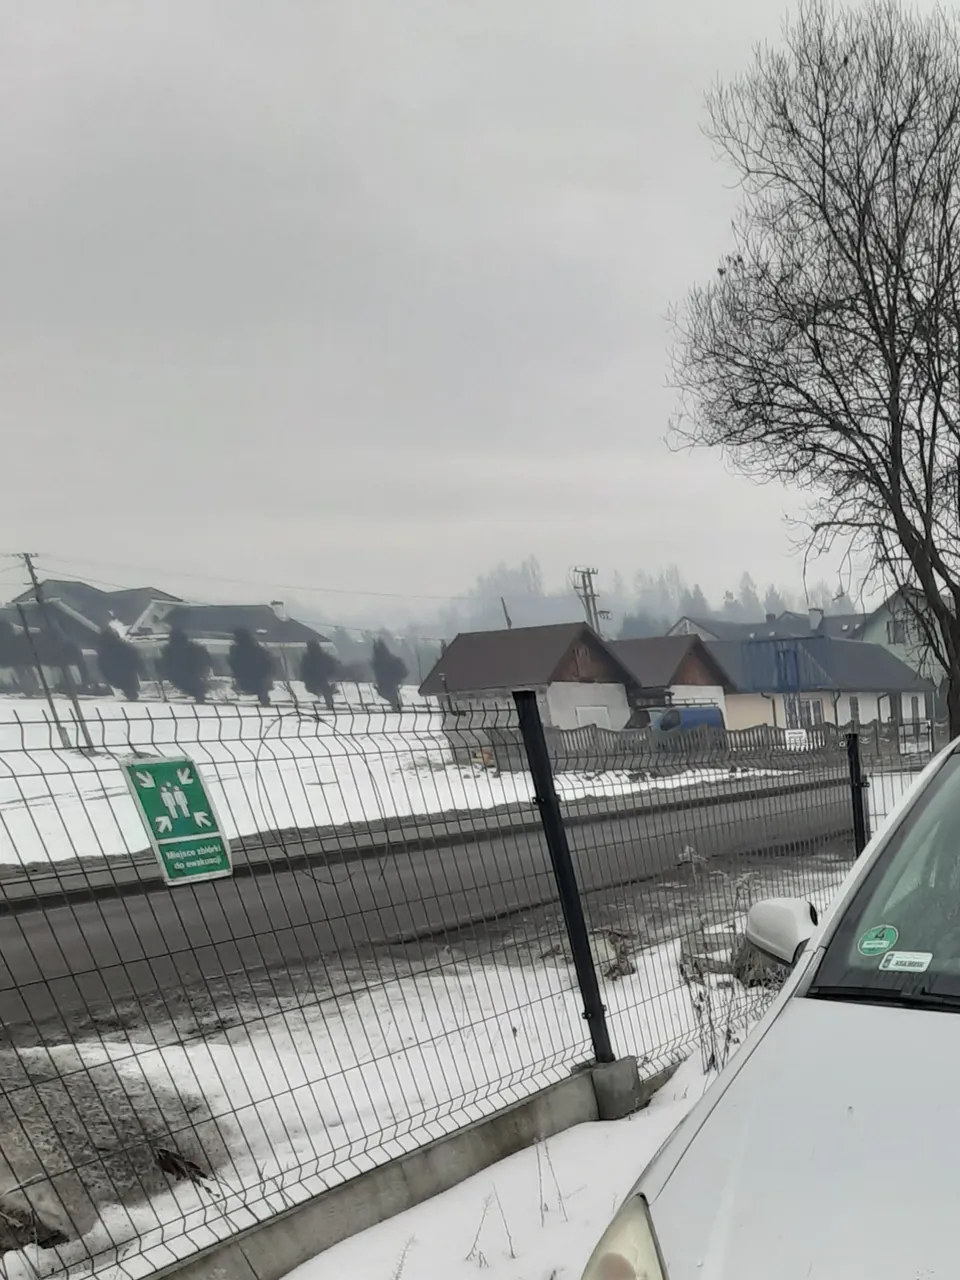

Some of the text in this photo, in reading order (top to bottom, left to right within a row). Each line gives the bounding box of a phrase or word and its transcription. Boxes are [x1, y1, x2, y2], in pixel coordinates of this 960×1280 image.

[165, 850, 196, 859] Miejsce
[186, 856, 222, 866] ewakuacji
[874, 927, 886, 940] 4
